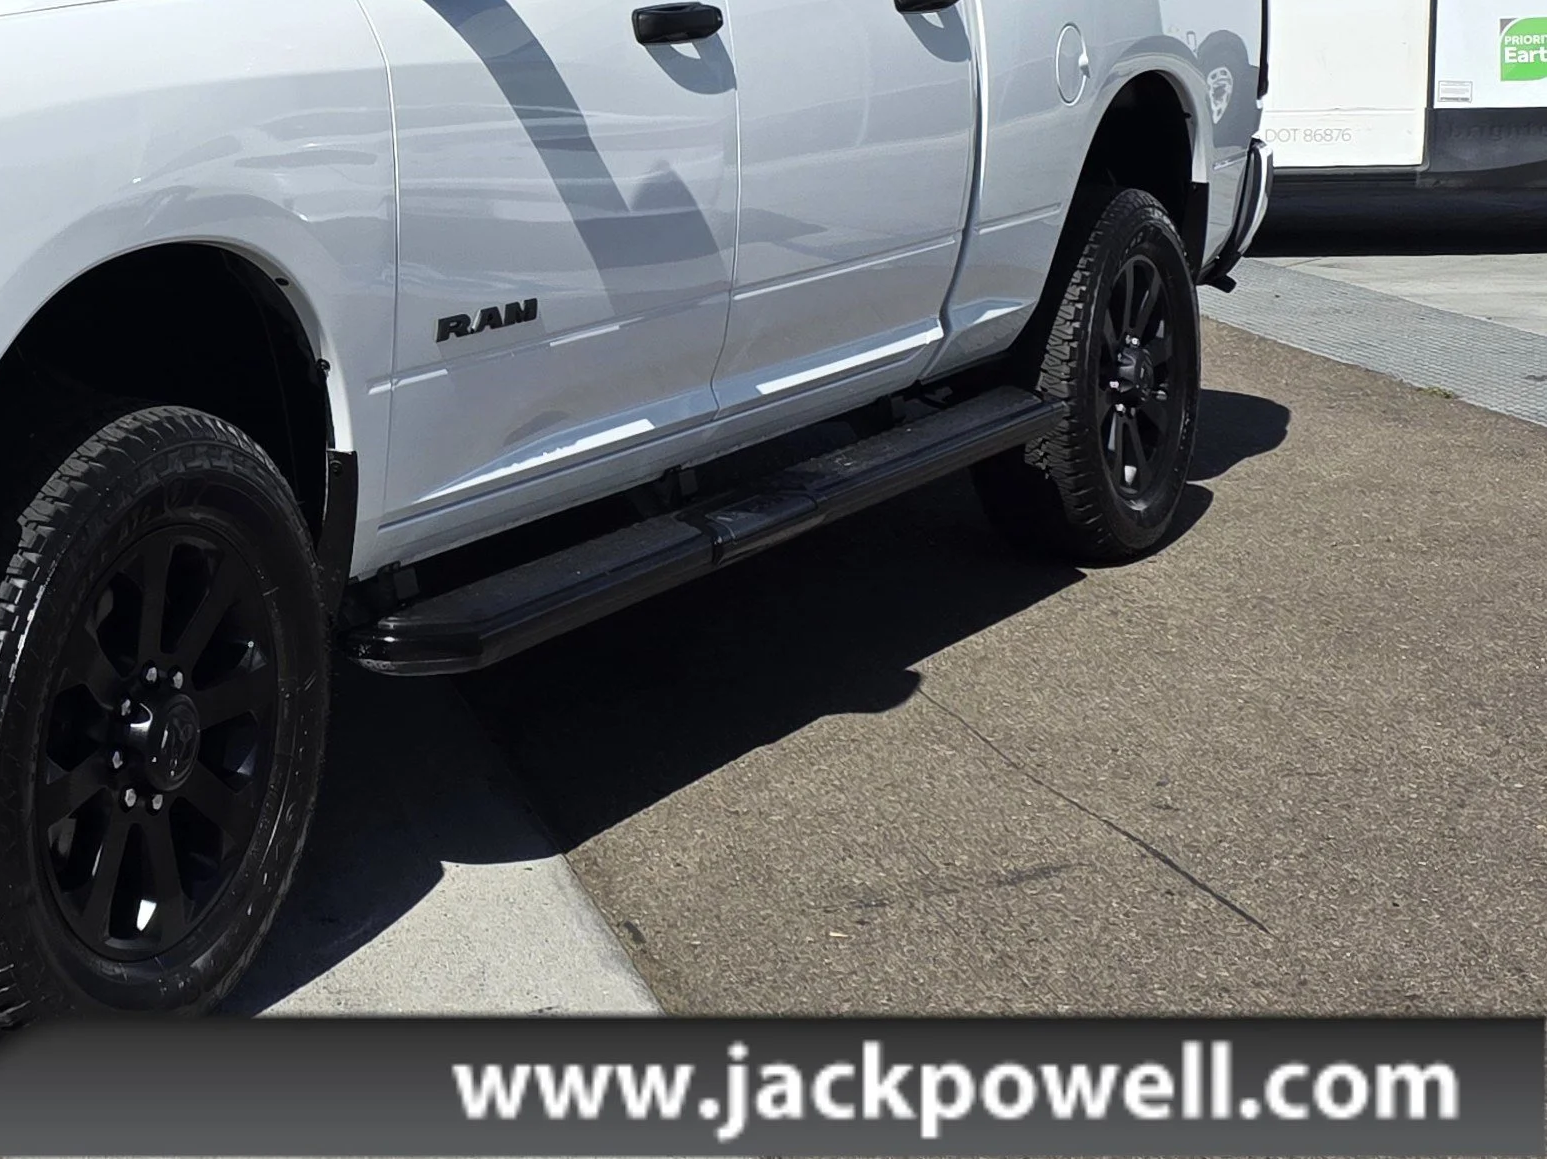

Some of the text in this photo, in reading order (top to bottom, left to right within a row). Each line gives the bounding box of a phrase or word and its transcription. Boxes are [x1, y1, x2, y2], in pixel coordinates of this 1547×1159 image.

[1265, 128, 1352, 142] DOT 86876
[435, 297, 538, 343] RAM
